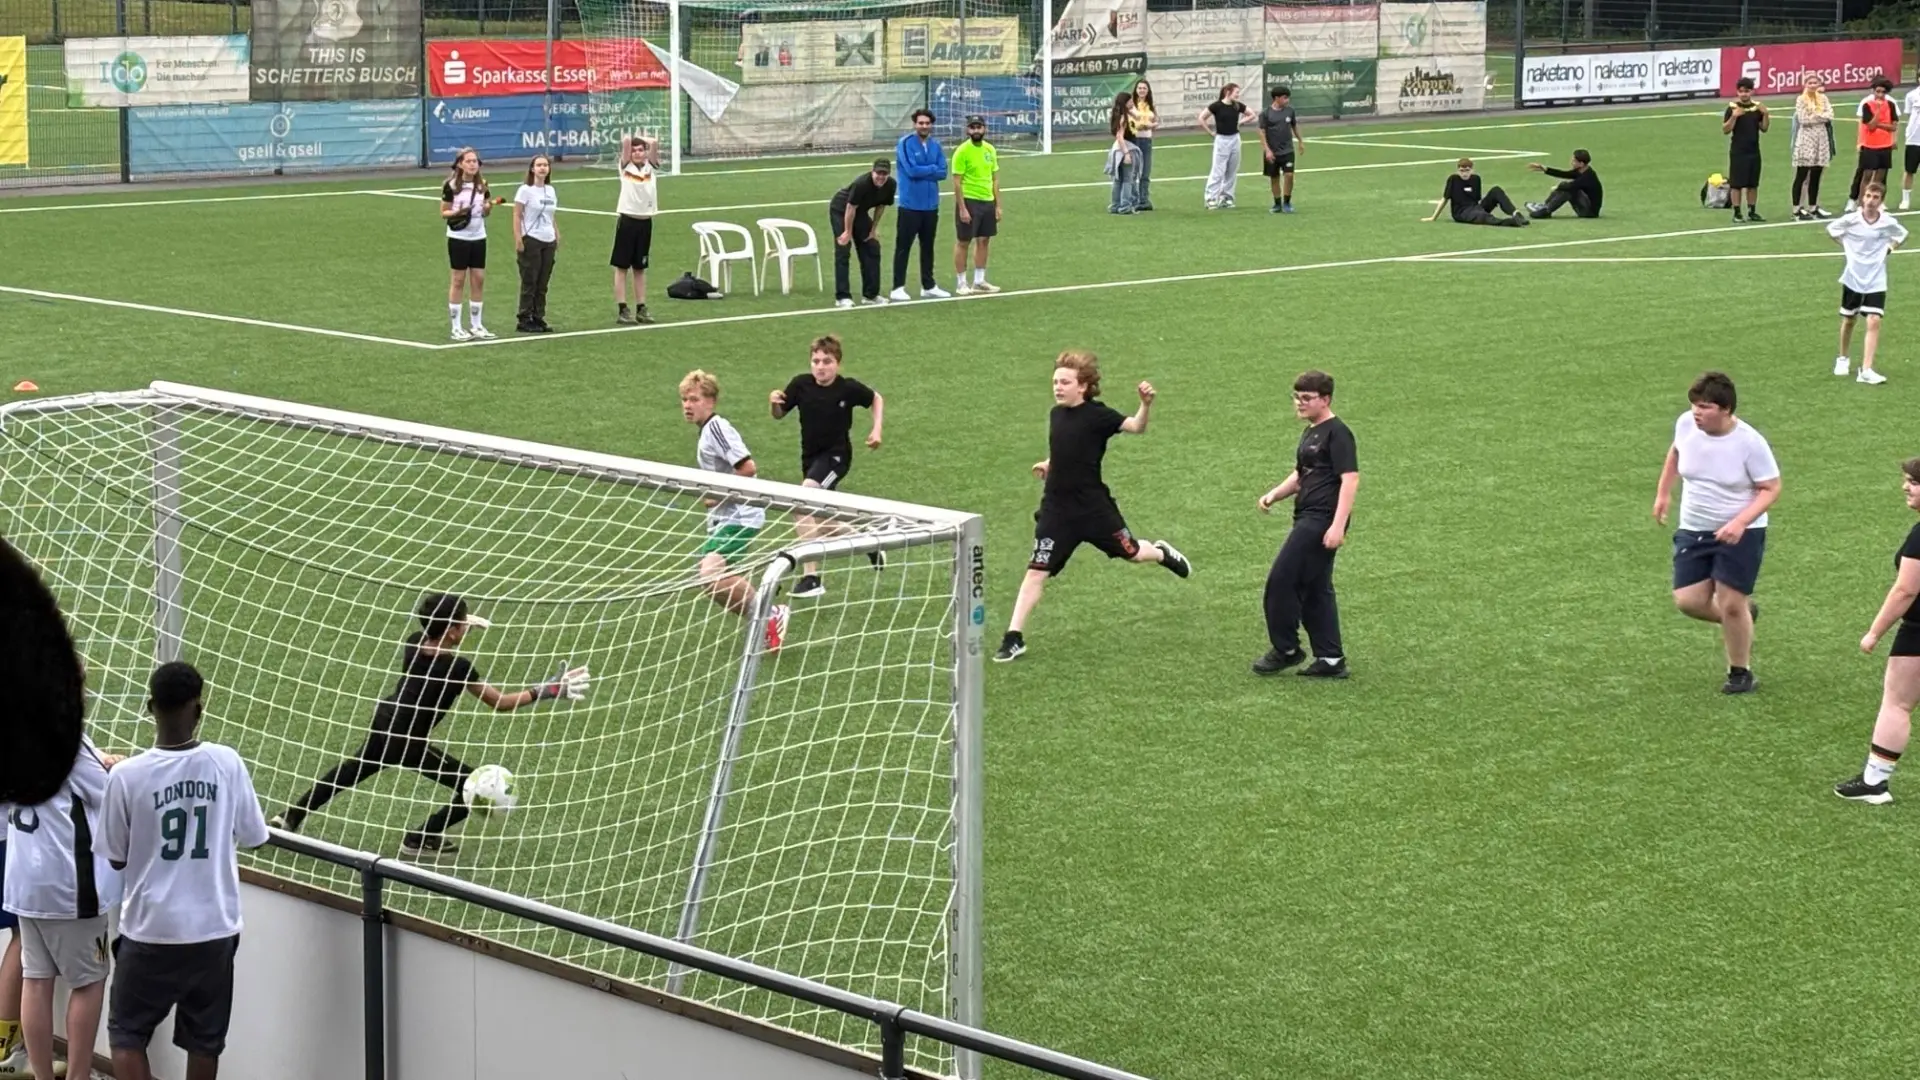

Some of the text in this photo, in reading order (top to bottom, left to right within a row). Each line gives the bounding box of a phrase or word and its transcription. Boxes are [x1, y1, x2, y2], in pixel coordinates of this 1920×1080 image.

[309, 47, 366, 63] THIS IS
[1106, 59, 1119, 71] 79
[1122, 57, 1143, 69] 477
[255, 67, 417, 84] SCHETTERS BUSCH
[472, 65, 597, 88] Sparkasse Essen
[1527, 62, 1585, 83] naketano
[1594, 60, 1648, 80] naketano
[1658, 57, 1713, 77] naketano
[1767, 63, 1883, 92] Sparksse Essen
[452, 107, 490, 119] Allbau
[239, 142, 323, 161] gsell & gsell
[152, 780, 218, 810] LONDON
[161, 805, 210, 861] 91
